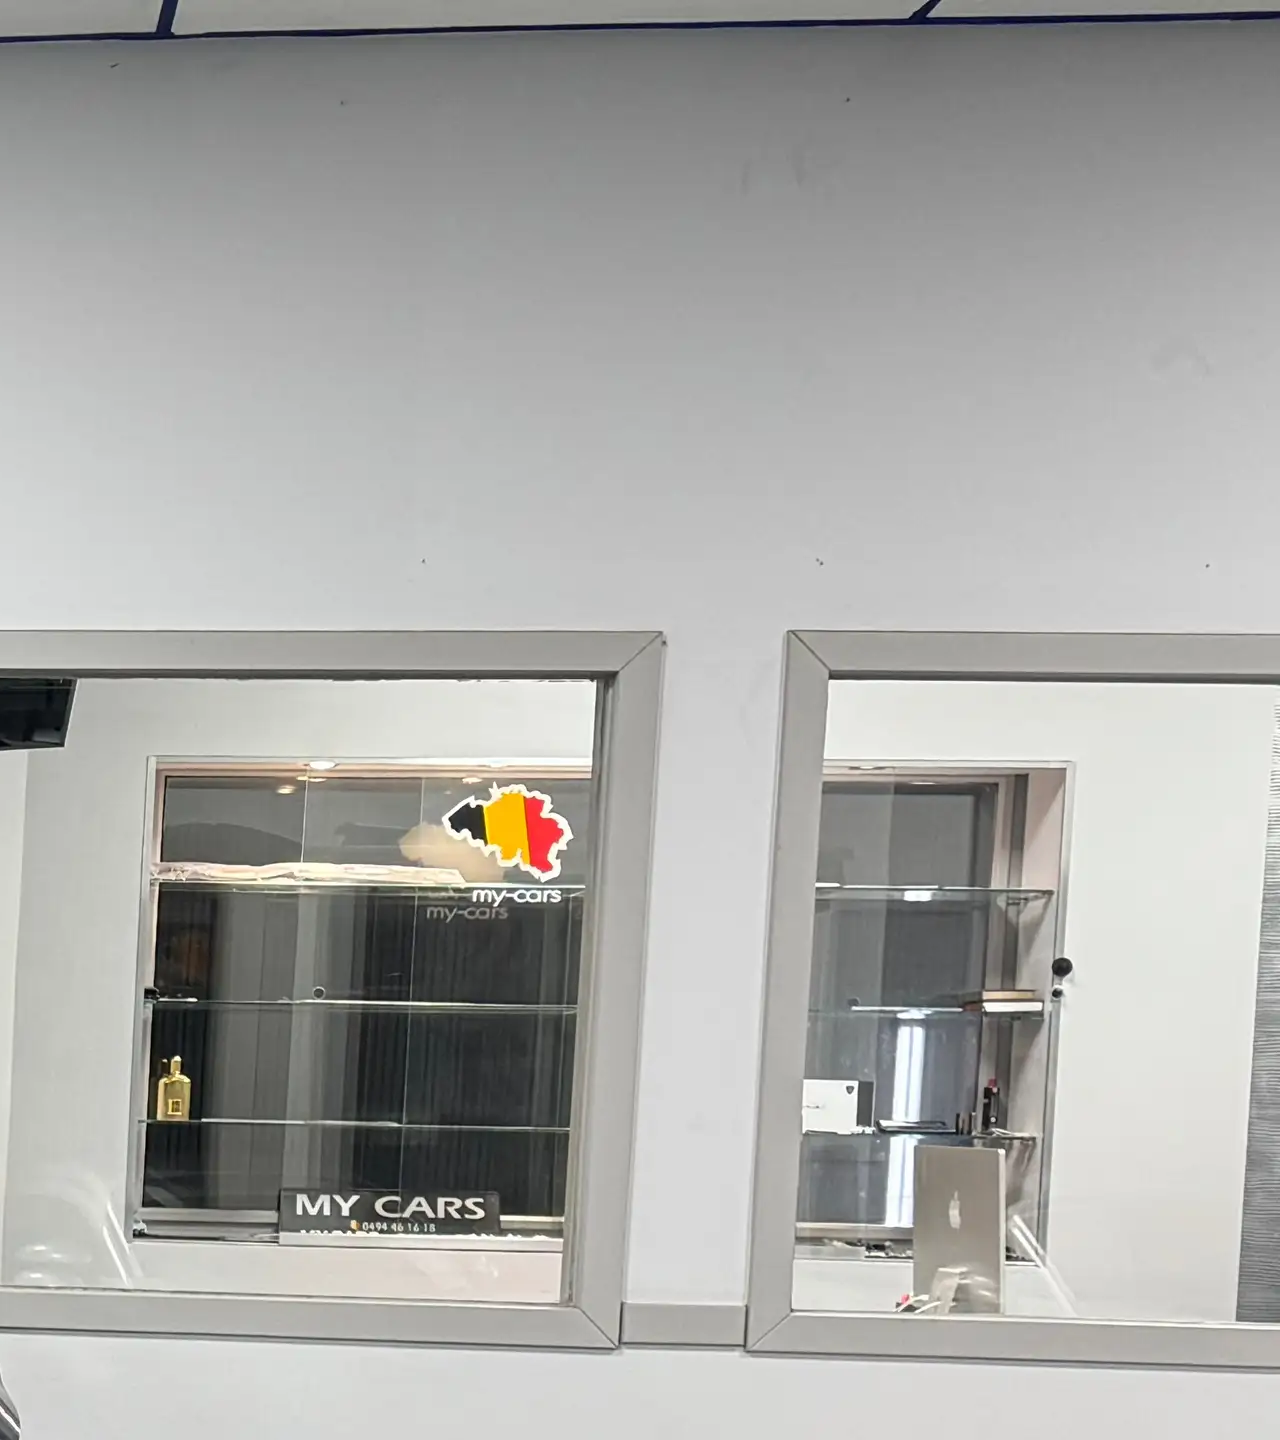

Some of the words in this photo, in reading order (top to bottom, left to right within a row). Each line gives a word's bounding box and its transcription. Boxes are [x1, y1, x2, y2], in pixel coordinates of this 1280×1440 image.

[471, 889, 562, 908] my-cars
[426, 906, 509, 924] my-cars
[296, 1193, 361, 1217] MY
[374, 1196, 487, 1220] CARS
[362, 1221, 388, 1232] 0494
[390, 1222, 404, 1232] 46
[407, 1223, 420, 1232] 16
